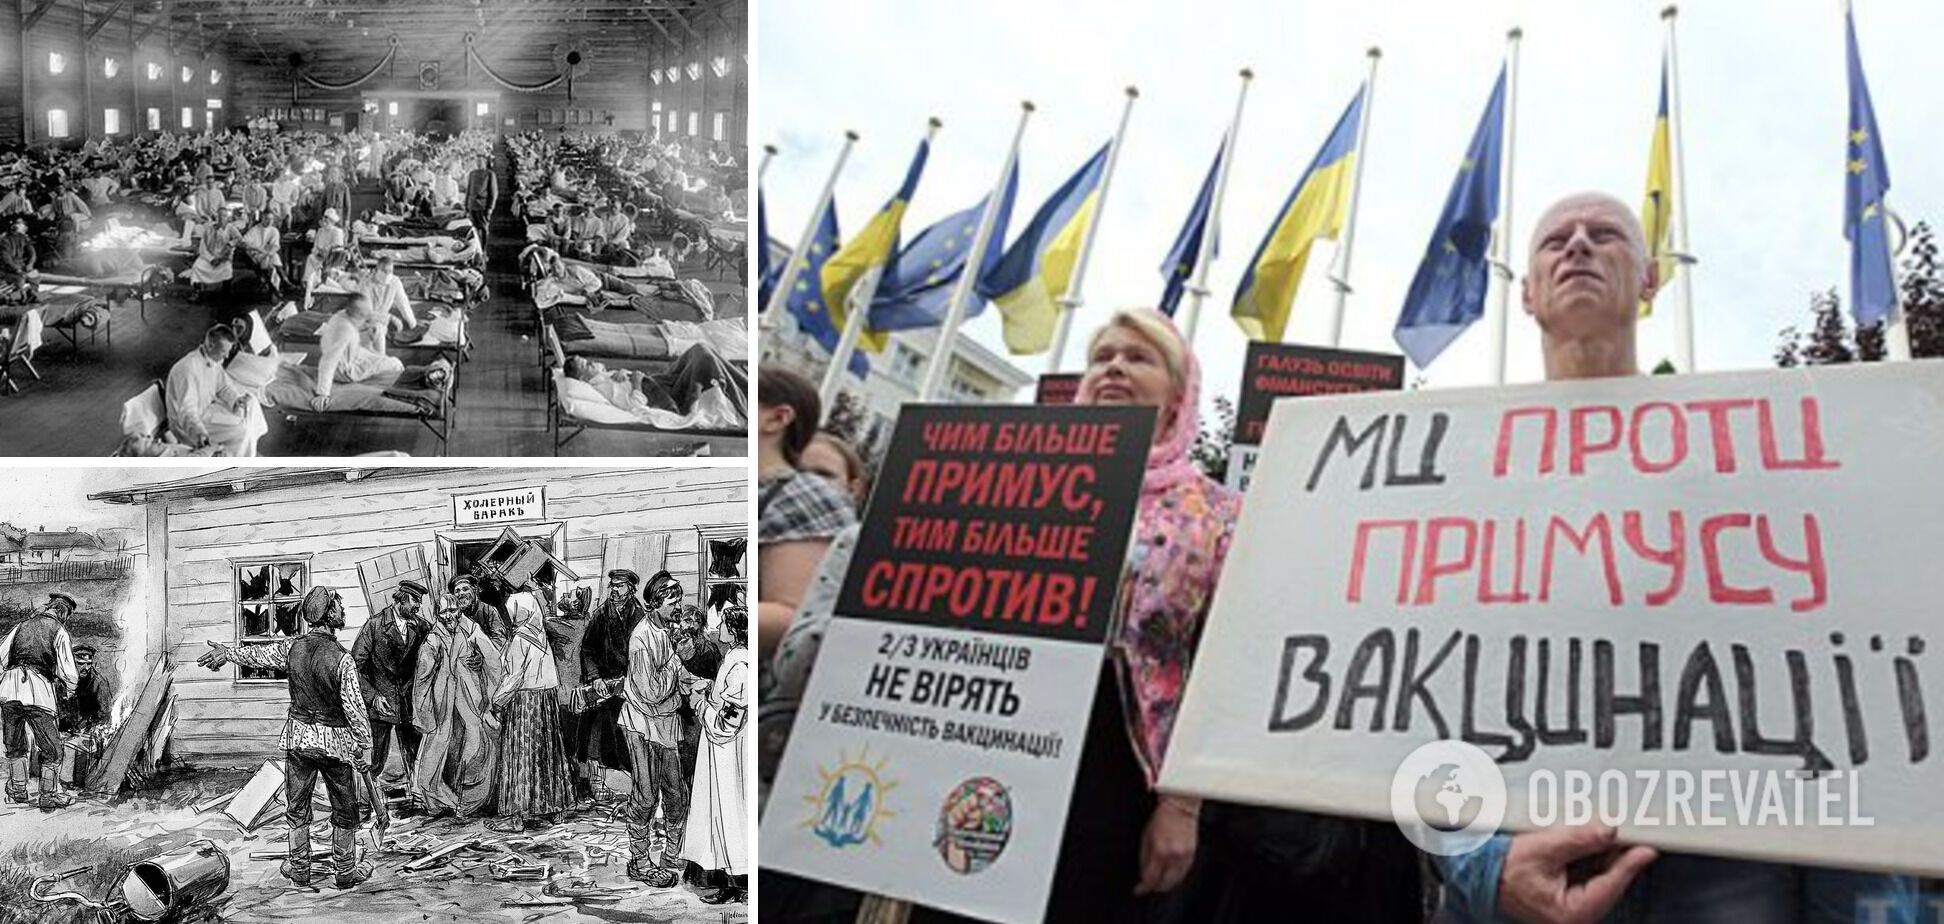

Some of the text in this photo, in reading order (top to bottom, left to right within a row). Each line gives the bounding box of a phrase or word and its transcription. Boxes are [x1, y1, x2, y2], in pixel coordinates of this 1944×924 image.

[923, 420, 1120, 456] ЧИМ БІЛЬШЕ
[463, 492, 535, 510] ХОЛЕРНЫЙ
[473, 507, 525, 520] БАРАКЪ
[902, 459, 1104, 520] ПРИМУС,
[893, 516, 1095, 562] ТИМ БІЛЬШЕ
[862, 560, 1097, 628] СПРОТИВ!
[878, 633, 1031, 673] 2/3 УКРАЇНЦІВ
[865, 663, 1021, 717] НЕ ВІРЯТЬ
[1268, 628, 1929, 780] ВАКЦИНАЦІЇ
[818, 702, 1063, 759] У БЕЗПЕЧНІСТЬ ВАКЦИНАЦІЇ!
